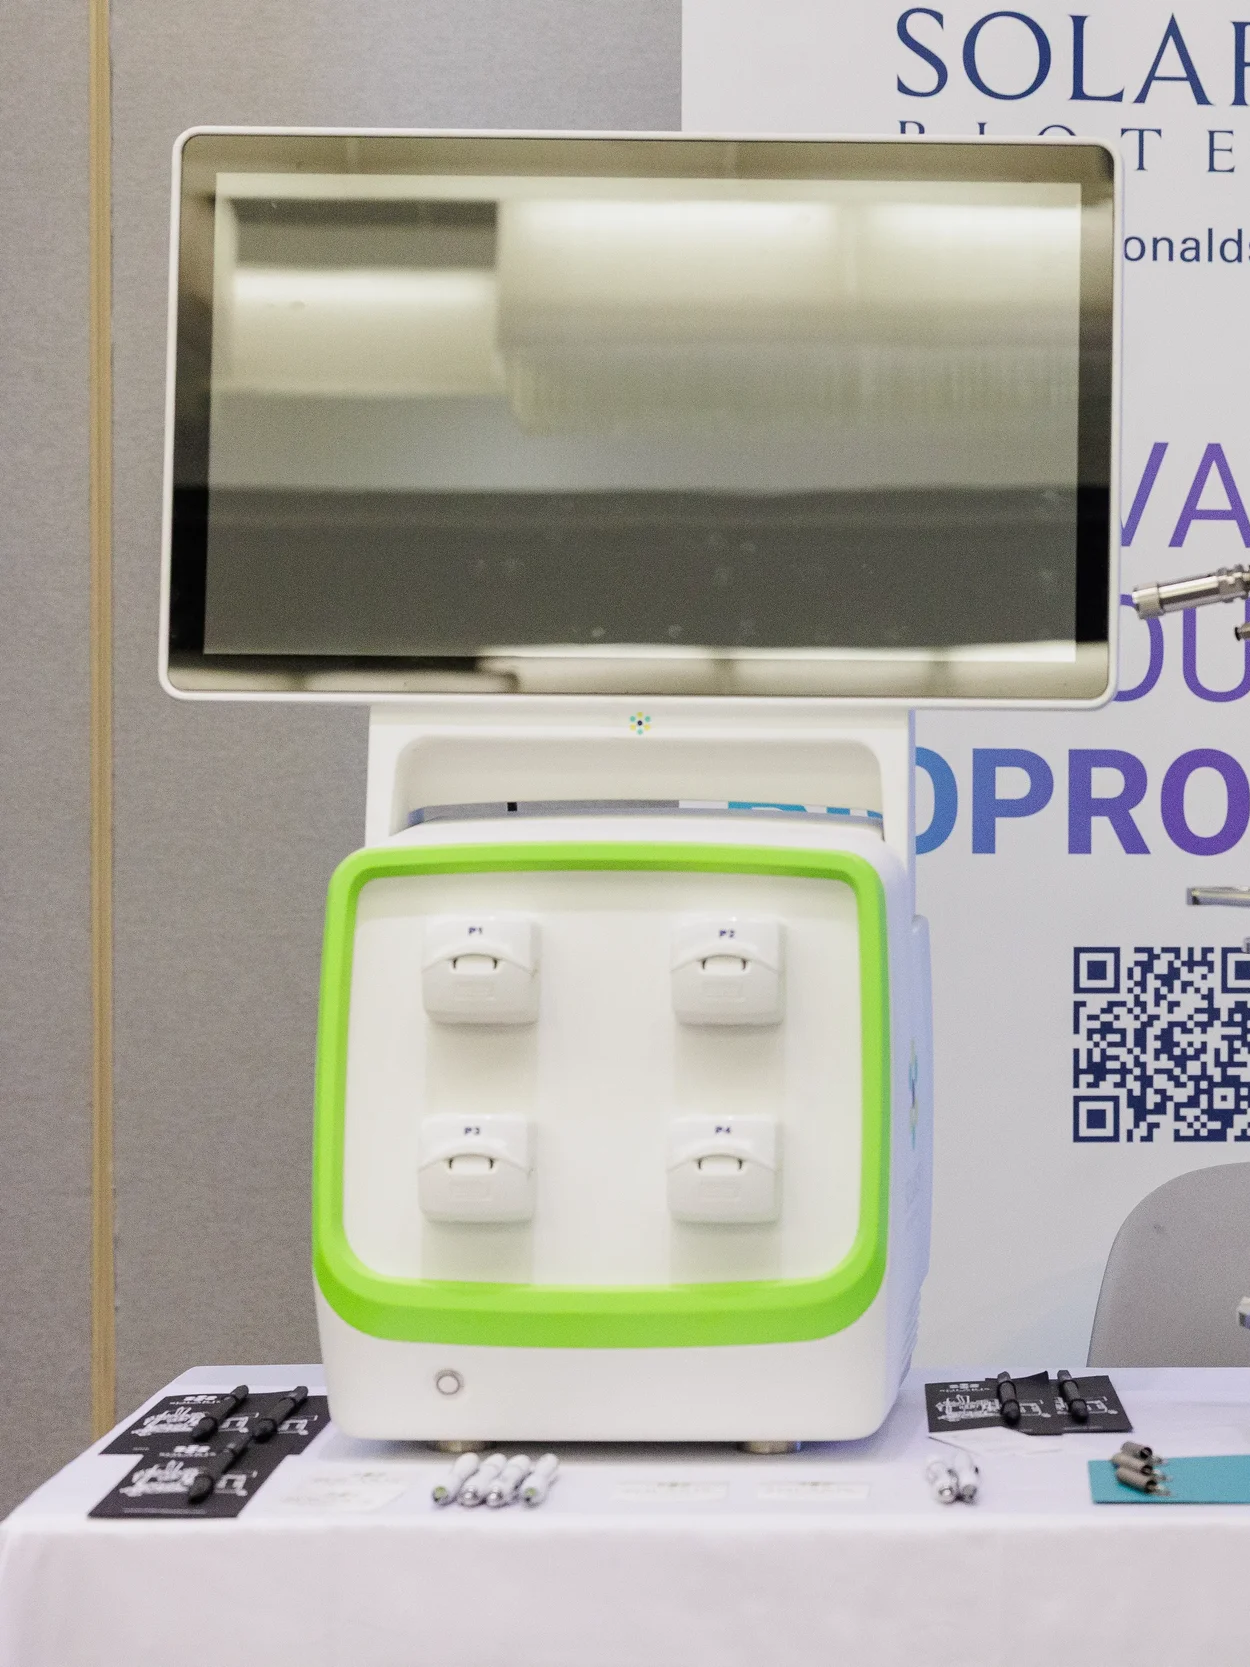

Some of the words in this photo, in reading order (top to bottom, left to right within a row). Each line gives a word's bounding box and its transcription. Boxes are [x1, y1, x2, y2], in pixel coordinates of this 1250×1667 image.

[468, 926, 483, 936] P1
[718, 930, 736, 939] P2
[715, 1125, 731, 1135] P4
